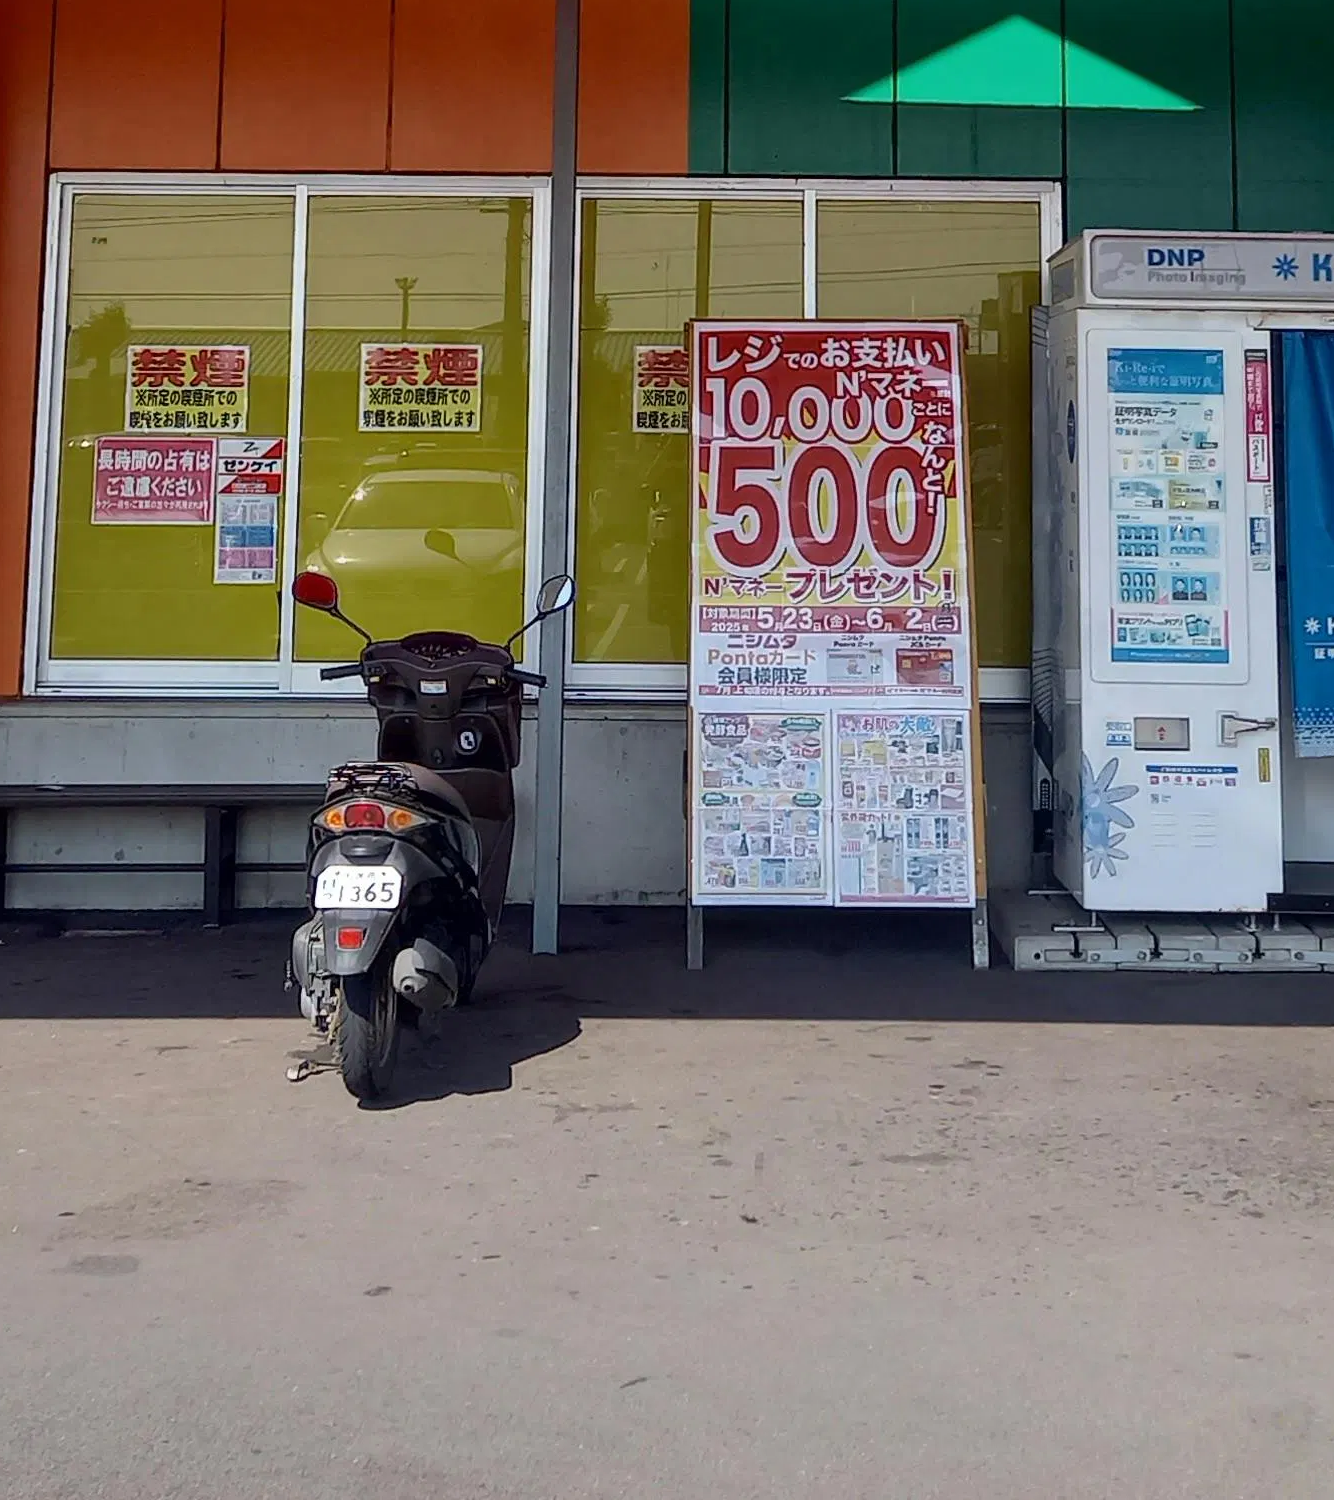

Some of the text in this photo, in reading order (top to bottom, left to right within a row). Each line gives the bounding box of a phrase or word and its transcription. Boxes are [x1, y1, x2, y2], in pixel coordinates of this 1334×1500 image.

[1147, 248, 1205, 268] DNP
[1147, 270, 1187, 284] Photo
[708, 335, 947, 372] レジでのお支払い
[132, 349, 245, 387] 禁煙
[365, 348, 478, 386] 禁煙
[706, 376, 916, 442] 10,000
[98, 449, 211, 472] 長時間の占有は
[223, 460, 277, 473] ゼンケイ
[107, 476, 202, 497] ご遠慮ください
[712, 442, 941, 568] 500
[727, 634, 798, 648] ニシムタ
[707, 649, 817, 666] Pontaカード
[717, 666, 808, 686] 会員様限定
[338, 882, 395, 902] 1365
